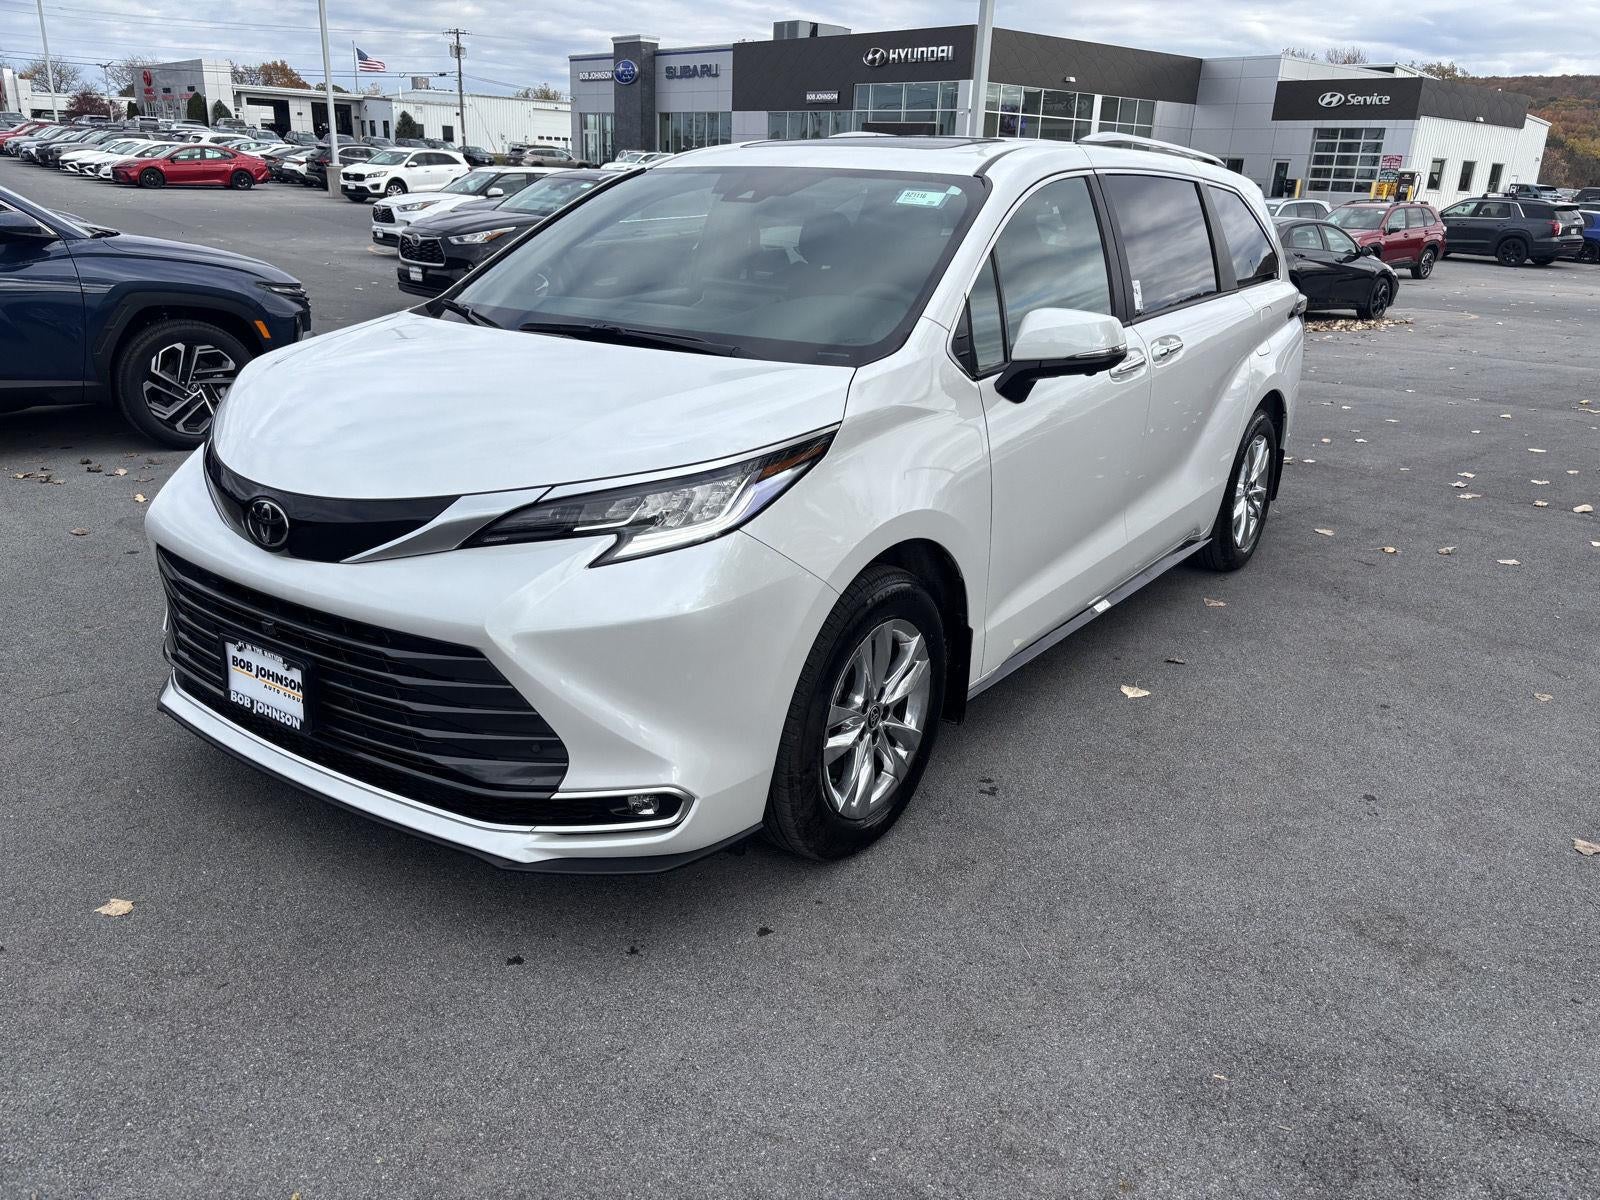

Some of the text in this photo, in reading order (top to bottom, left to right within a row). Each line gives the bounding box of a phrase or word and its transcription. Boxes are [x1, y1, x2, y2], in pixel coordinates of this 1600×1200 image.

[889, 46, 953, 63] HYUNDAI
[579, 71, 612, 80] BOB JOHNSON
[665, 64, 720, 80] SUBARU
[806, 93, 838, 101] BOB JOHNSON
[1346, 93, 1390, 105] Service
[232, 655, 303, 693] BOB JOHNSON
[263, 684, 281, 695] AUTO
[230, 690, 300, 730] BOB JOHNSON
